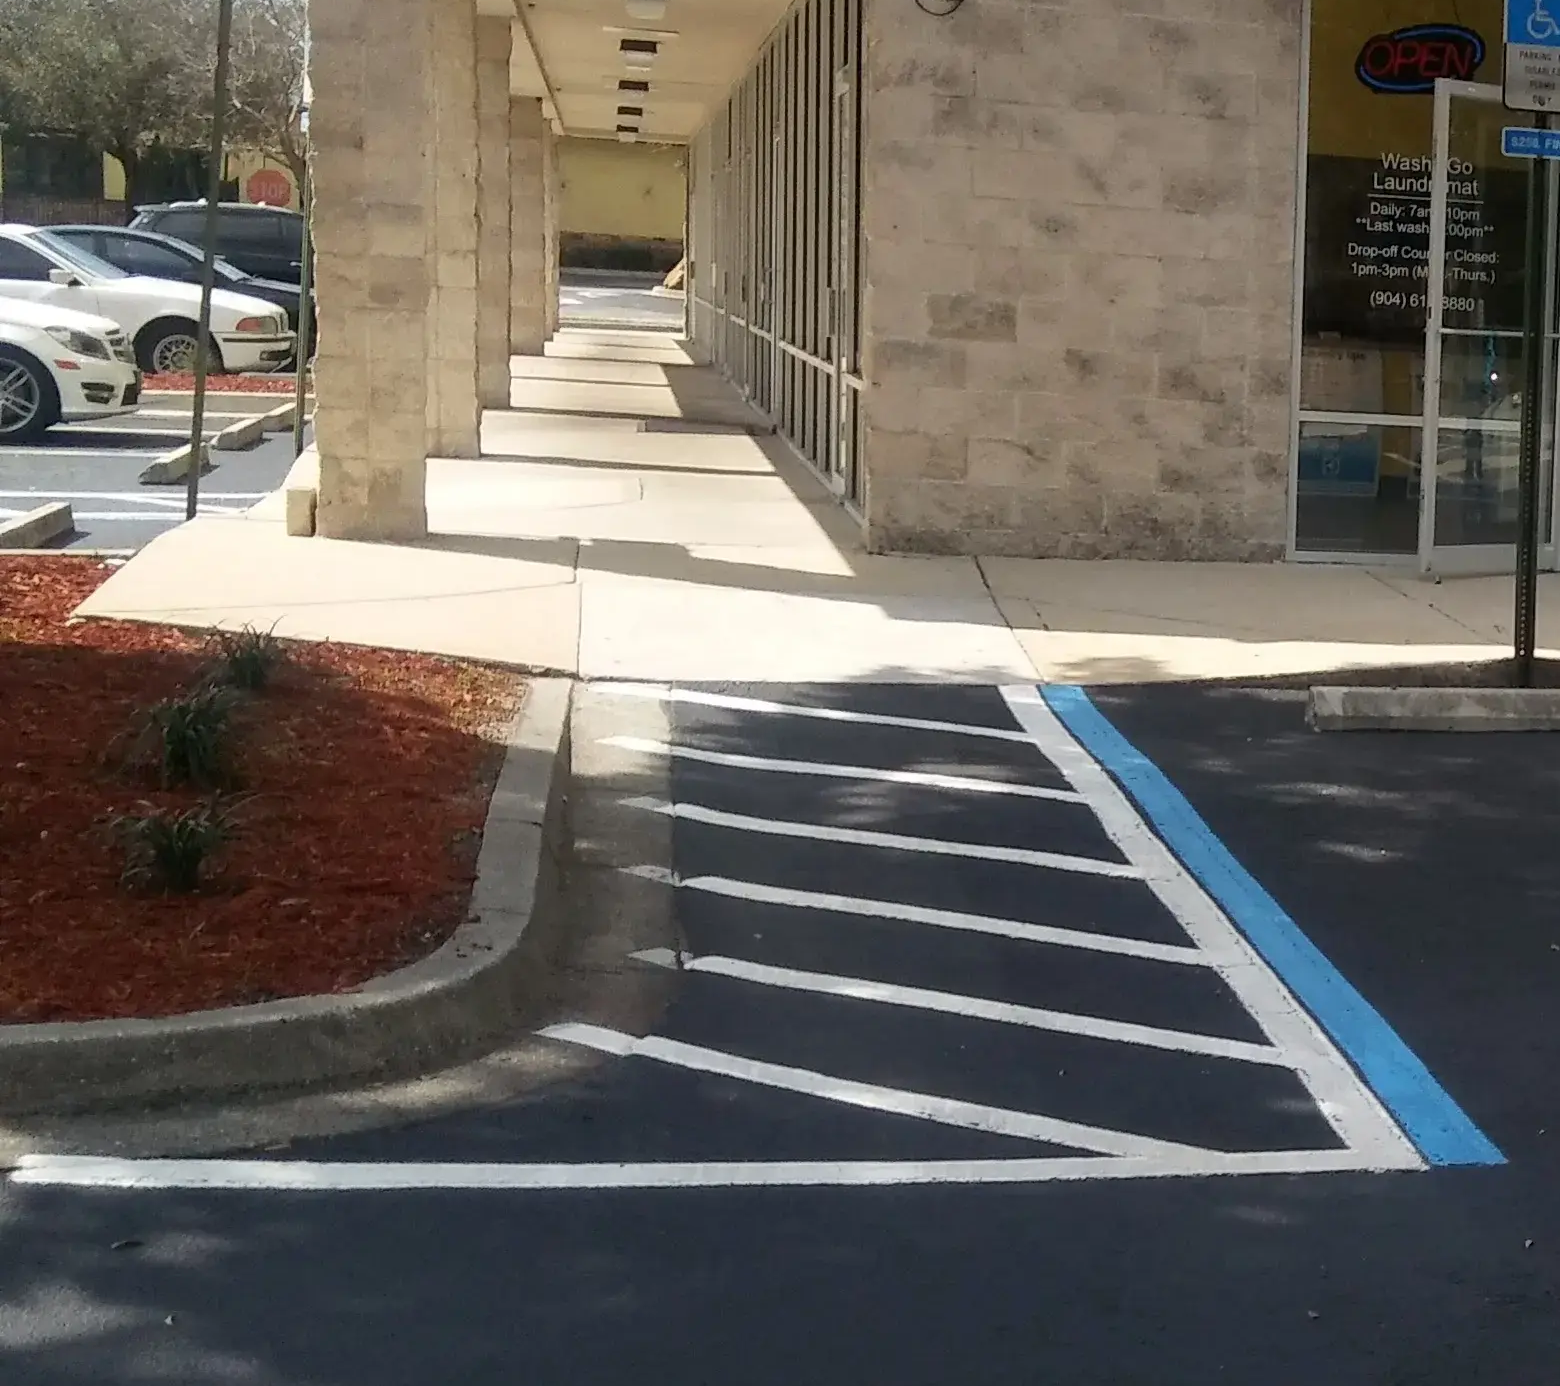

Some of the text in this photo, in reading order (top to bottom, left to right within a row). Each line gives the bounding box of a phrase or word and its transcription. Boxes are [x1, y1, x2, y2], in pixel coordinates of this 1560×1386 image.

[1366, 41, 1472, 77] OPEN
[1381, 152, 1473, 175] Wash Go
[1373, 172, 1479, 196] Laundrmat
[1348, 242, 1399, 258] Drop-off
[1454, 249, 1500, 264] Closed:
[1351, 262, 1409, 278] 1pm-3pm
[1370, 290, 1406, 308] (904)
